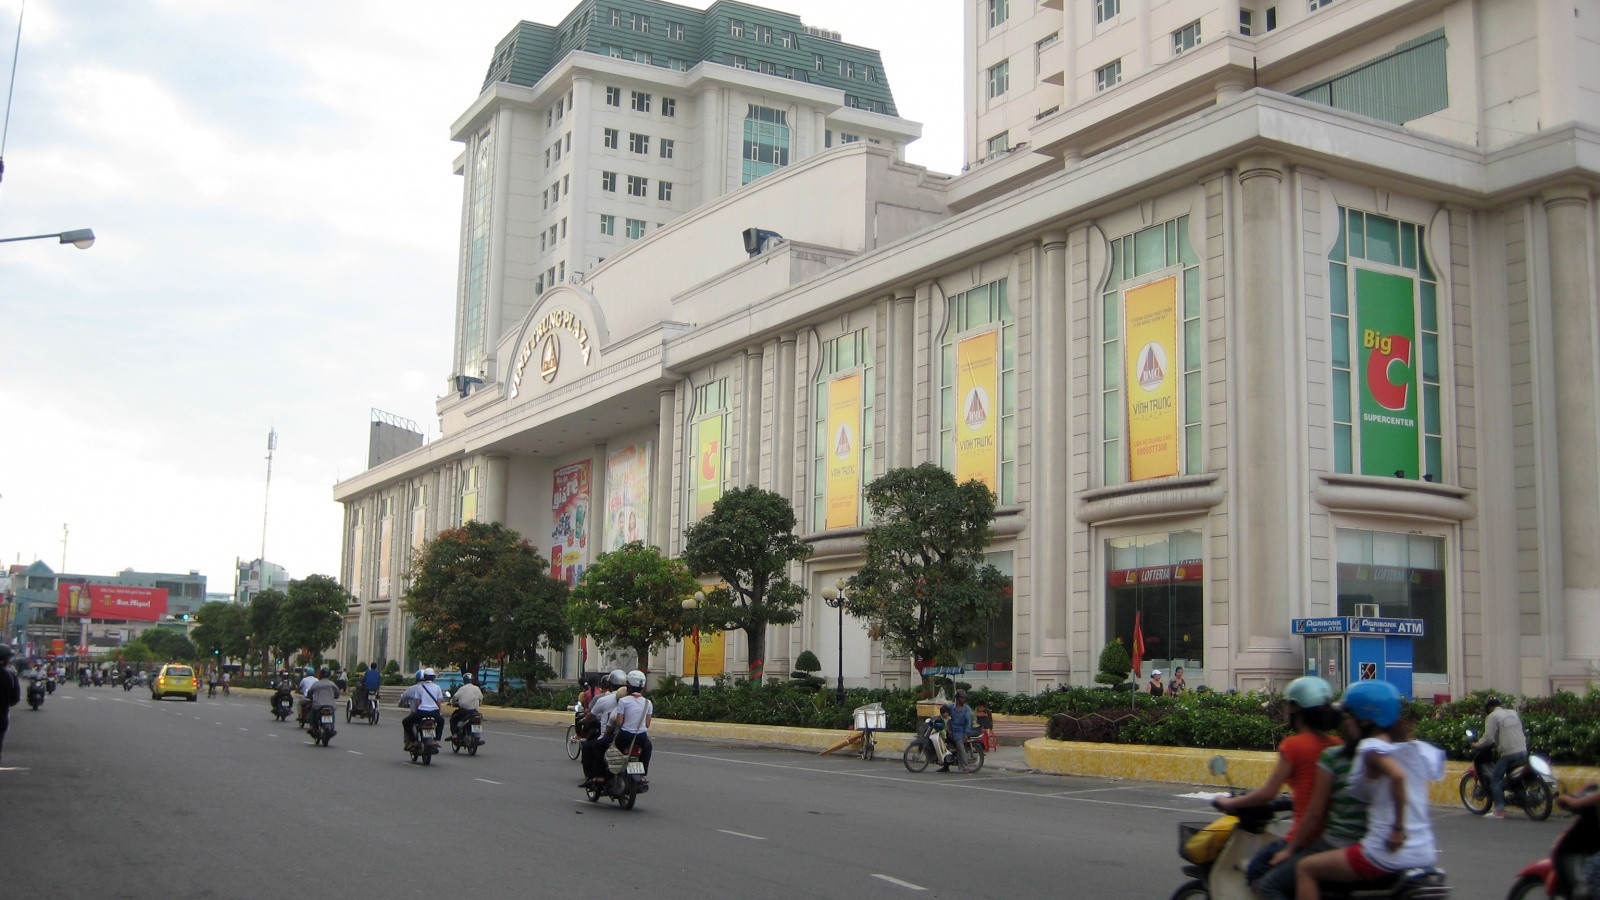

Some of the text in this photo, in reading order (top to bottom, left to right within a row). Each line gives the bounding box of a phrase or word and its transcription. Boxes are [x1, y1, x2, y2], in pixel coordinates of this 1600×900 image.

[563, 310, 591, 366] PLAZA
[1364, 329, 1411, 411] Big C
[1150, 396, 1172, 412] TRUNG
[1363, 413, 1414, 427] SUPERCENTER
[1141, 568, 1170, 582] LOTTERIA
[129, 599, 151, 608] Miguel
[1398, 622, 1422, 633] ATM
